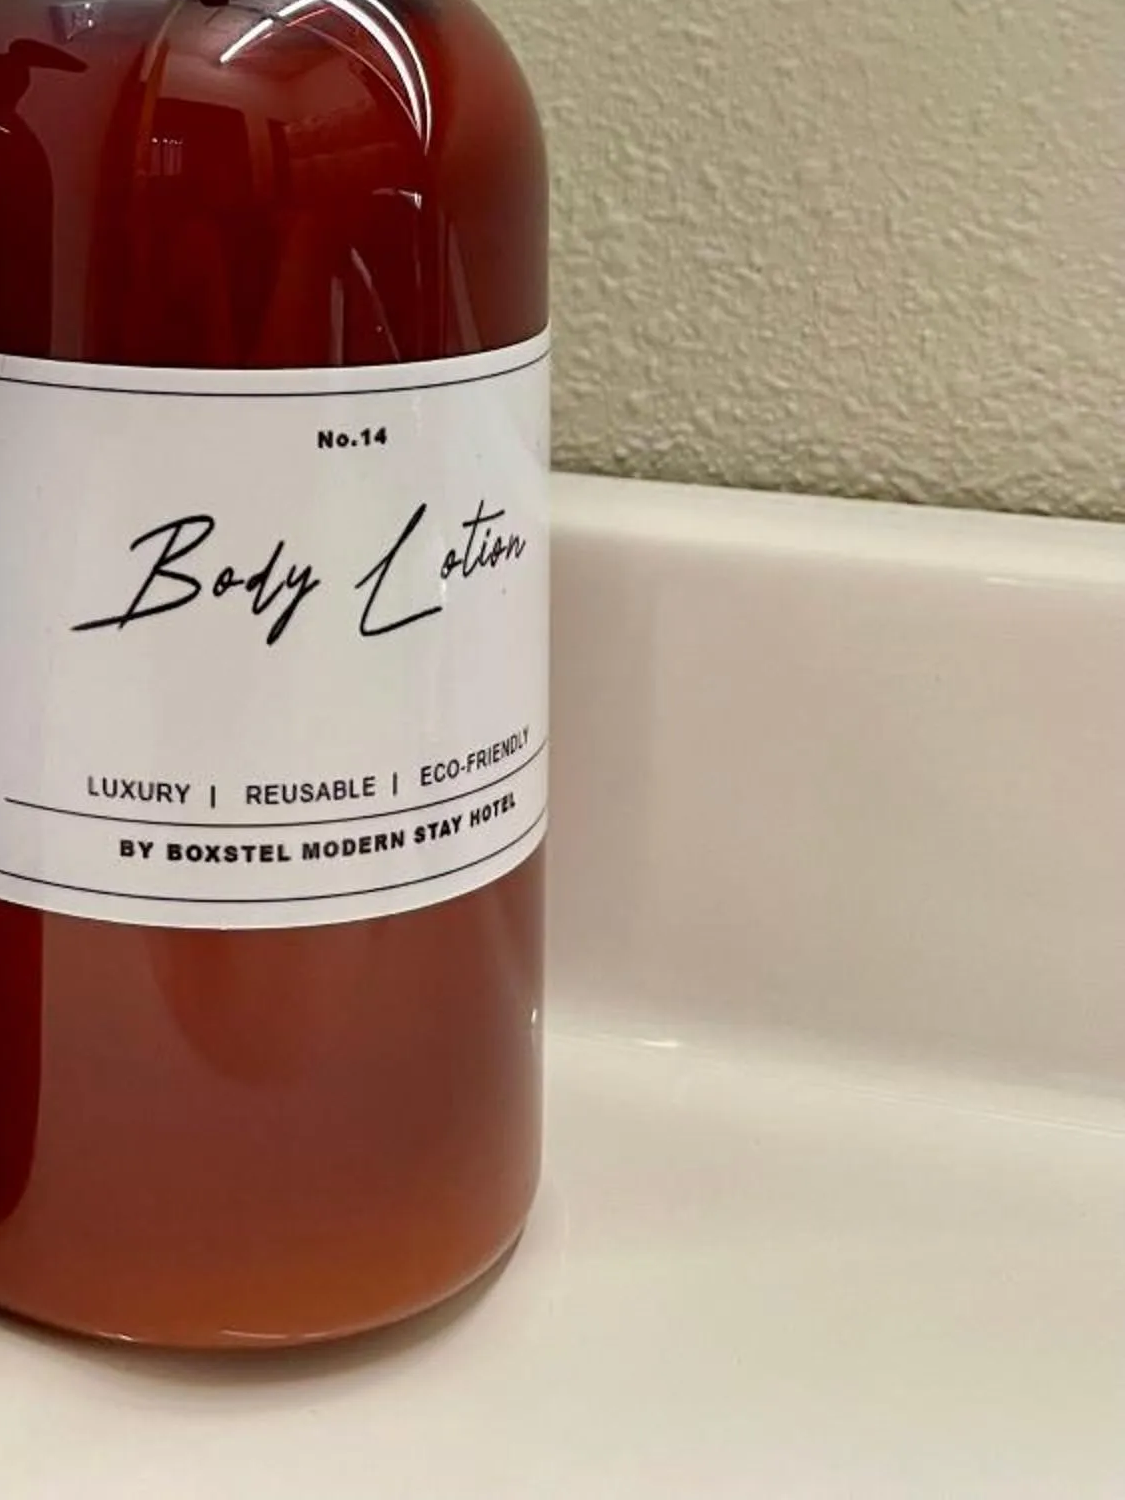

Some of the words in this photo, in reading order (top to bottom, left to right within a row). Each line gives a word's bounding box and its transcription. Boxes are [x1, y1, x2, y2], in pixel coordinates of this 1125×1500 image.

[316, 426, 388, 450] No.14
[69, 513, 322, 647] Body
[87, 775, 192, 805] LUXURY
[245, 775, 376, 806] REUSABLE
[419, 726, 529, 788] ECO-FRIENDLY
[119, 838, 155, 860] BY
[165, 842, 292, 864] BOXSTEL
[301, 828, 406, 861] MODERN
[412, 813, 464, 845] STAY
[469, 791, 517, 829] HOTEL
